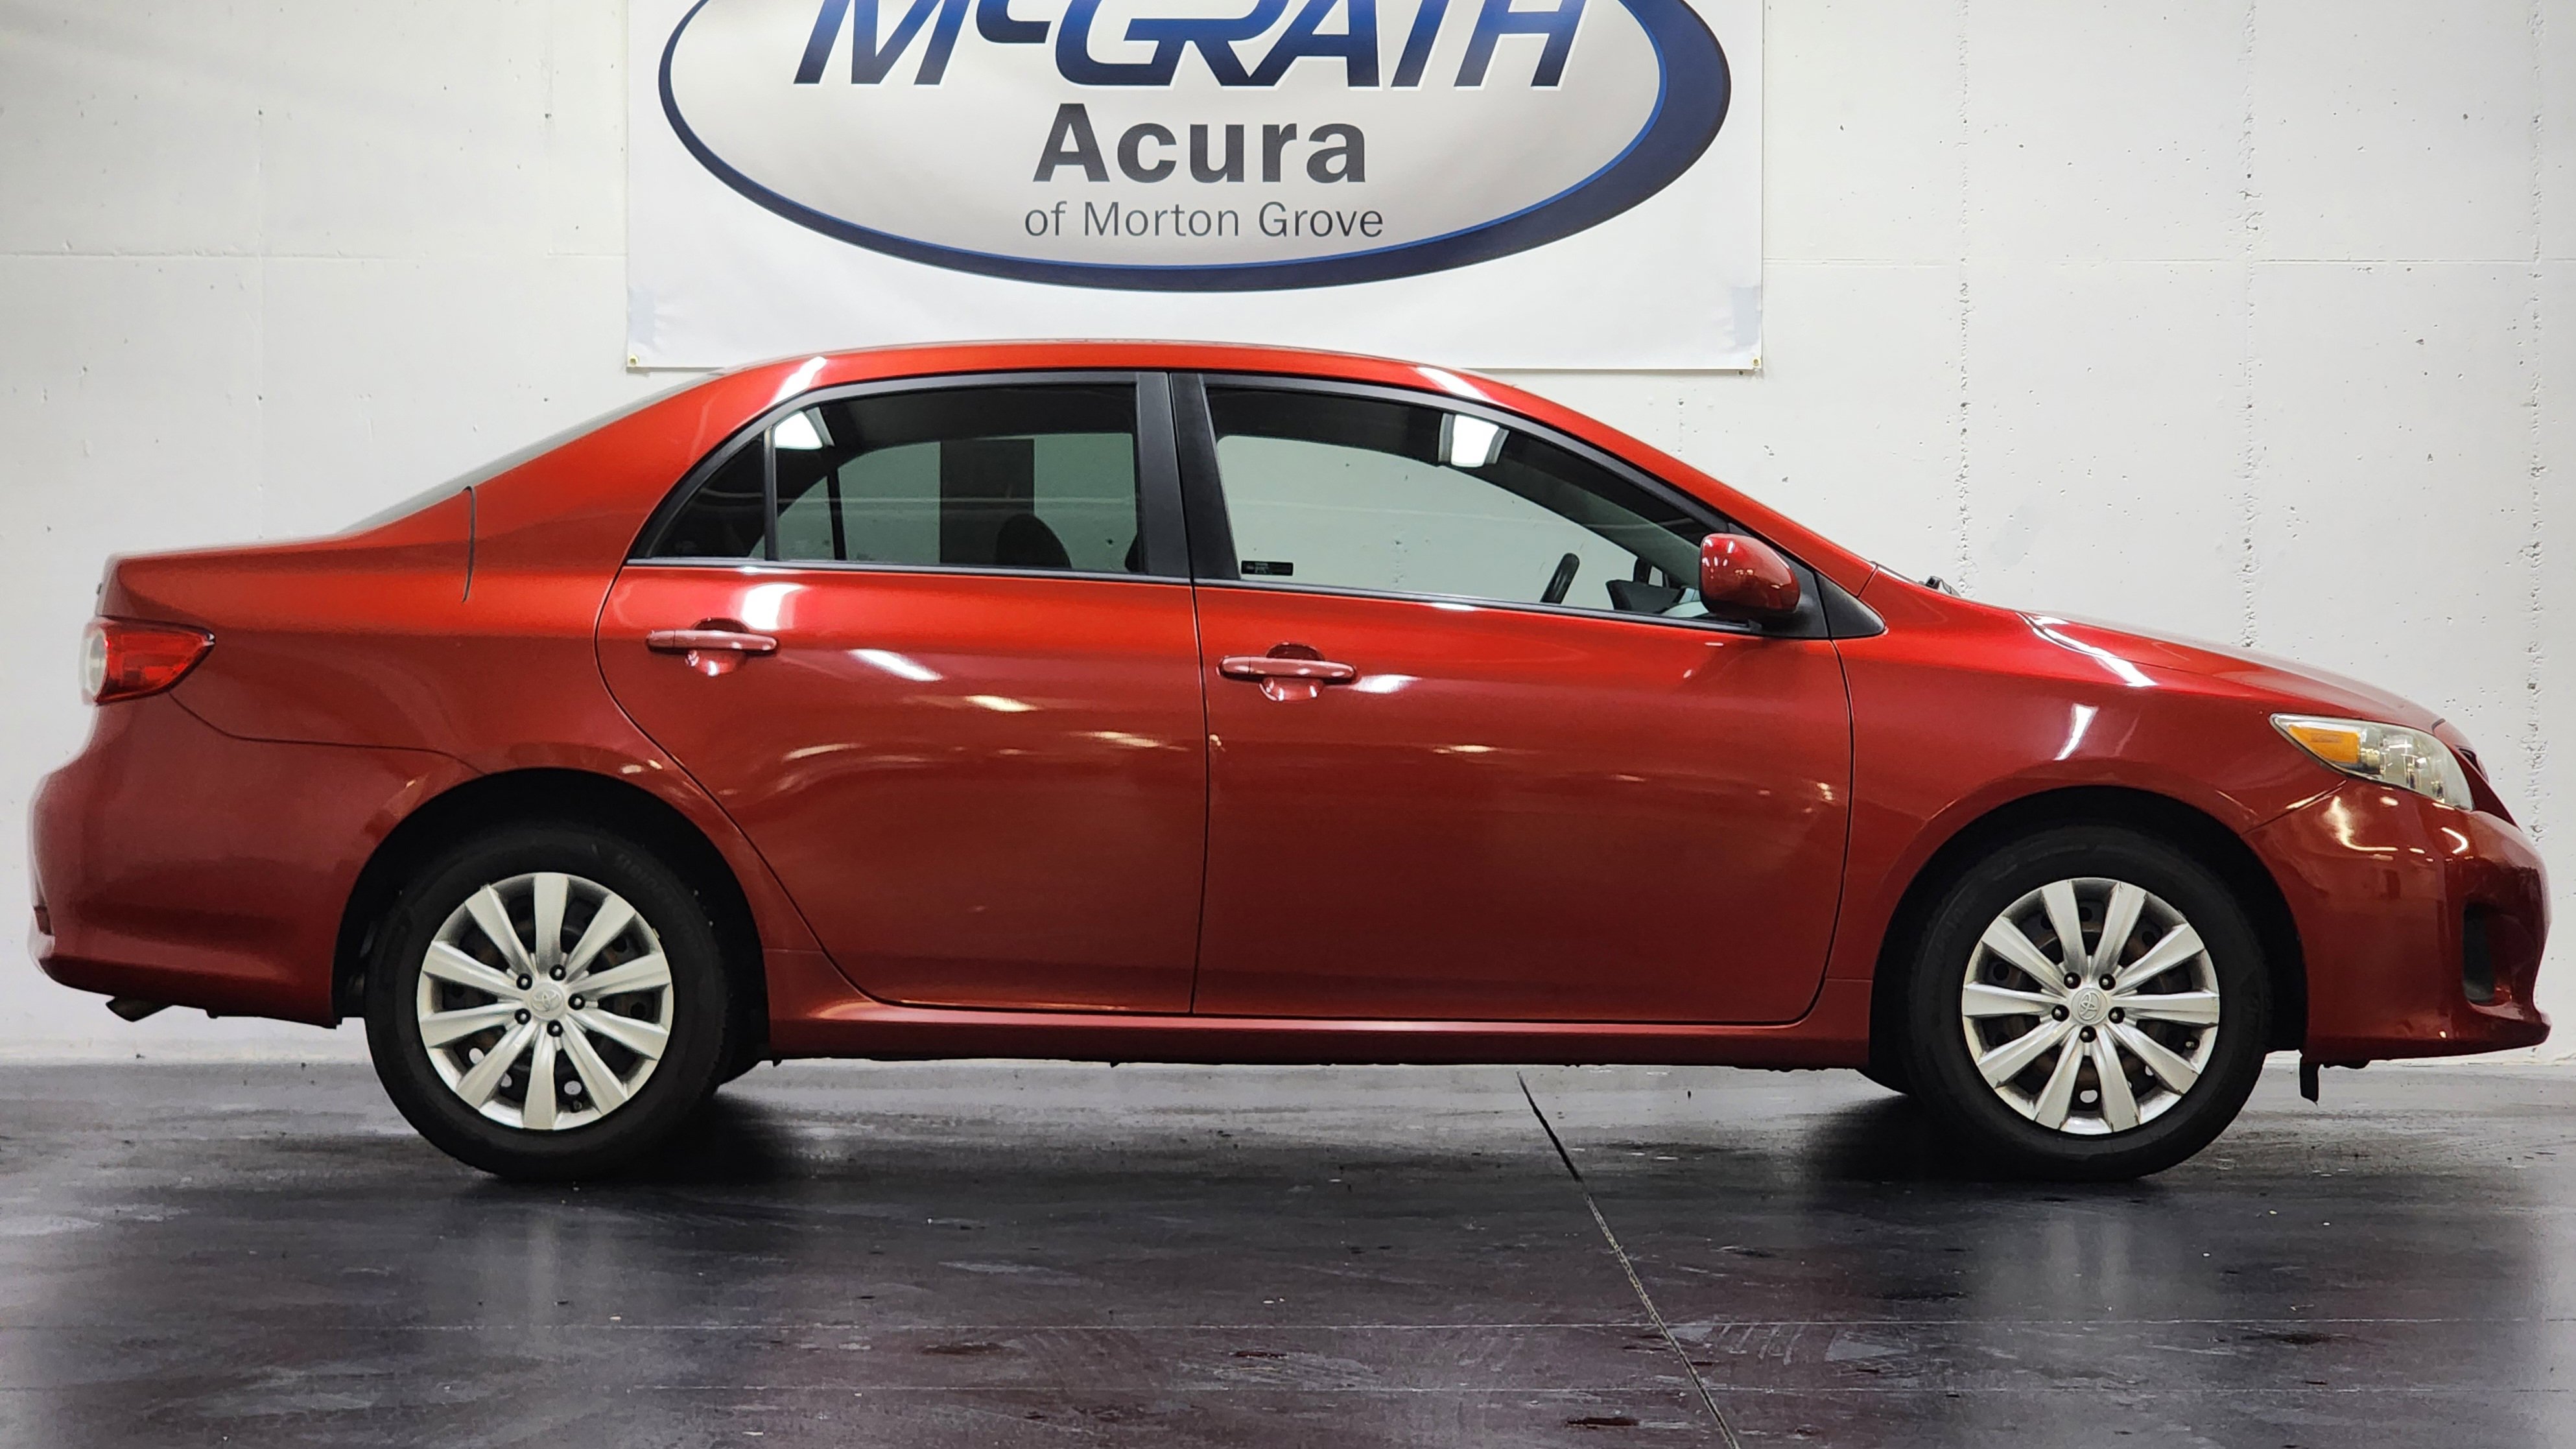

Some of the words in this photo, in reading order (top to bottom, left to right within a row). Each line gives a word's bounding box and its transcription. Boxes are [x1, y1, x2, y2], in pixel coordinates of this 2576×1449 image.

[1033, 103, 1366, 183] Acura
[1025, 202, 1067, 237] of
[1085, 202, 1239, 237] Morton
[1258, 202, 1383, 237] Grove
